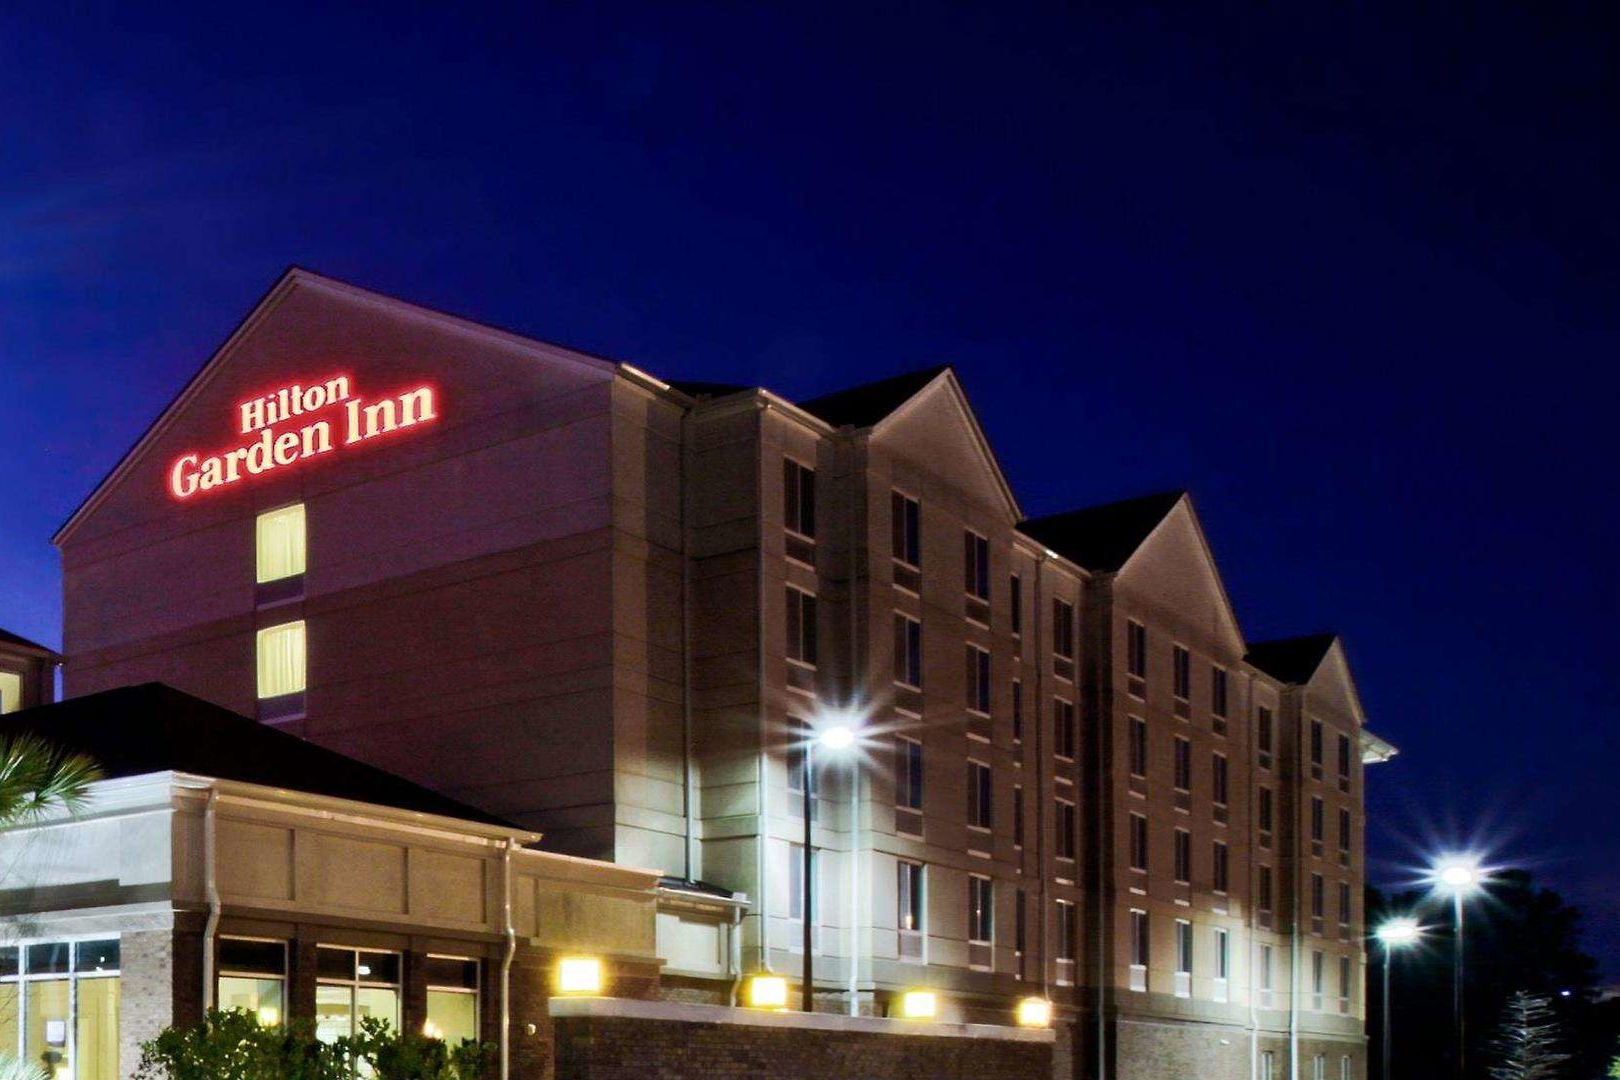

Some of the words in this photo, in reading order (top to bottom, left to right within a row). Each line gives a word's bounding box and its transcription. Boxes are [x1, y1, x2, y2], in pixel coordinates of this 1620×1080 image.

[172, 420, 333, 498] Garden
[345, 386, 436, 445] Inn
[240, 375, 350, 434] Hilton
